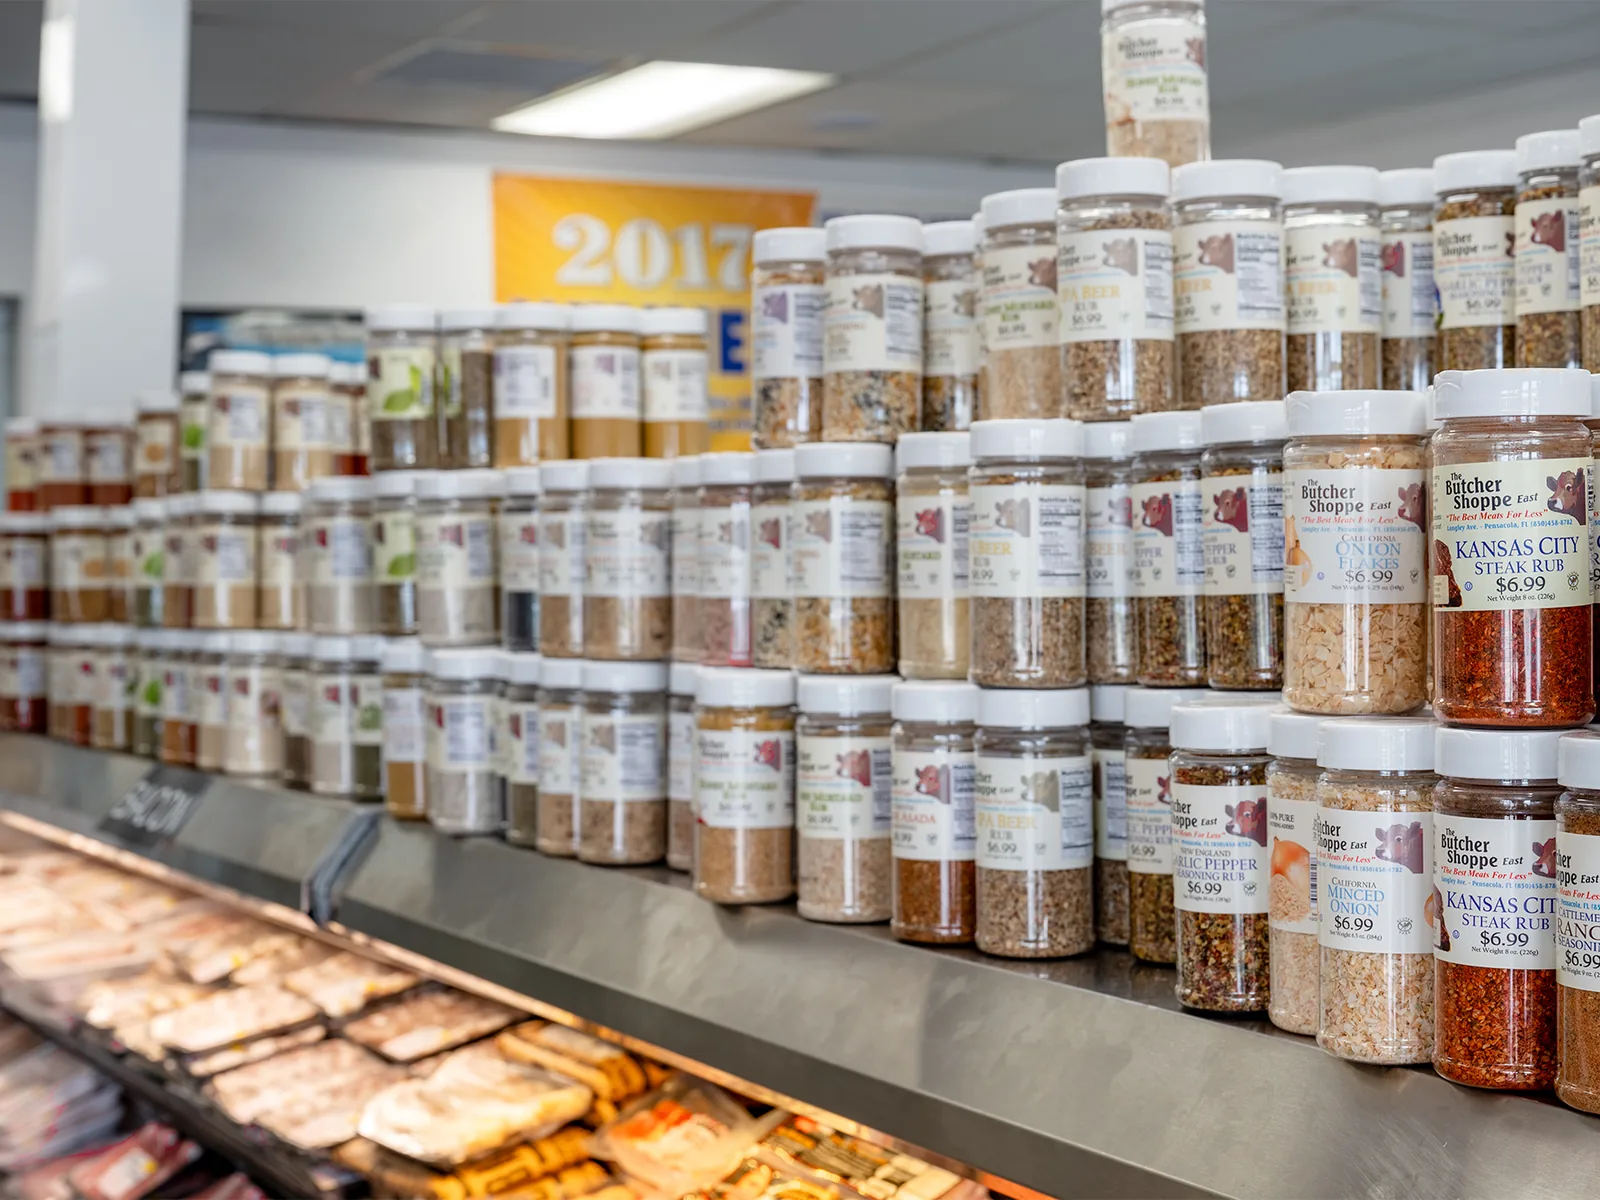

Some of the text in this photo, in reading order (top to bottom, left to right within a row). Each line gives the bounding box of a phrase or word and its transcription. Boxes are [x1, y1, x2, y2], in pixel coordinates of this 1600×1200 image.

[552, 212, 756, 294] 2017
[1451, 472, 1462, 480] The
[1307, 479, 1319, 488] The
[1446, 477, 1502, 496] Butcher
[1301, 484, 1356, 500] Butcher
[1309, 499, 1391, 515] Shoppe East
[1454, 493, 1538, 512] Shoppe East
[1461, 512, 1478, 521] Best
[1479, 511, 1504, 520] Meats
[1506, 510, 1522, 519] For
[1524, 509, 1549, 518] Less"
[1484, 522, 1520, 530] Pensacola,
[1530, 519, 1573, 528] (850)458-8782
[1335, 540, 1402, 556] ONION
[1456, 536, 1580, 559] KANSAS CITY
[1339, 556, 1400, 570] FLAKES
[1474, 558, 1565, 576] STEAK RUB
[1345, 570, 1393, 584] $6.99
[1496, 575, 1546, 595] $6.99
[1499, 594, 1522, 602] Weight
[1537, 592, 1556, 601] (226g)
[1200, 818, 1218, 826] East
[1278, 813, 1295, 823] PURE
[1445, 828, 1455, 837] The
[1350, 842, 1367, 850] East
[1441, 834, 1490, 853] Butcher
[1181, 847, 1231, 857] NEW ENGLAND
[1342, 855, 1354, 863] For
[1174, 856, 1259, 870] ARLIC PEPPER
[1447, 850, 1524, 870] Shoppe East
[1222, 872, 1245, 881] RUB
[1453, 867, 1467, 876] Best
[1467, 868, 1490, 879] Meats
[1491, 871, 1507, 879] For
[1509, 872, 1533, 880] Less"
[1580, 874, 1599, 885] East
[1187, 881, 1222, 895] $6.99
[1331, 876, 1377, 889] CALIFORNIA
[1472, 880, 1504, 889] Pensacola,
[1327, 884, 1385, 902] MINCED
[1572, 889, 1585, 898] For
[1330, 899, 1379, 917] ONION
[1446, 890, 1556, 915] KANSAS CIT
[1462, 912, 1550, 931] STEAK RUB
[1559, 907, 1600, 923] CATTLEME
[1334, 915, 1374, 932] $6.99
[1557, 918, 1600, 941] RANC
[1335, 930, 1351, 938] Weight
[1480, 930, 1529, 947] $6.99
[1559, 935, 1600, 952] SEASONI
[1482, 947, 1504, 956] Weight
[1519, 948, 1539, 957] (226g)
[1565, 949, 1600, 969] $6.99
[1567, 966, 1581, 976] Weight
